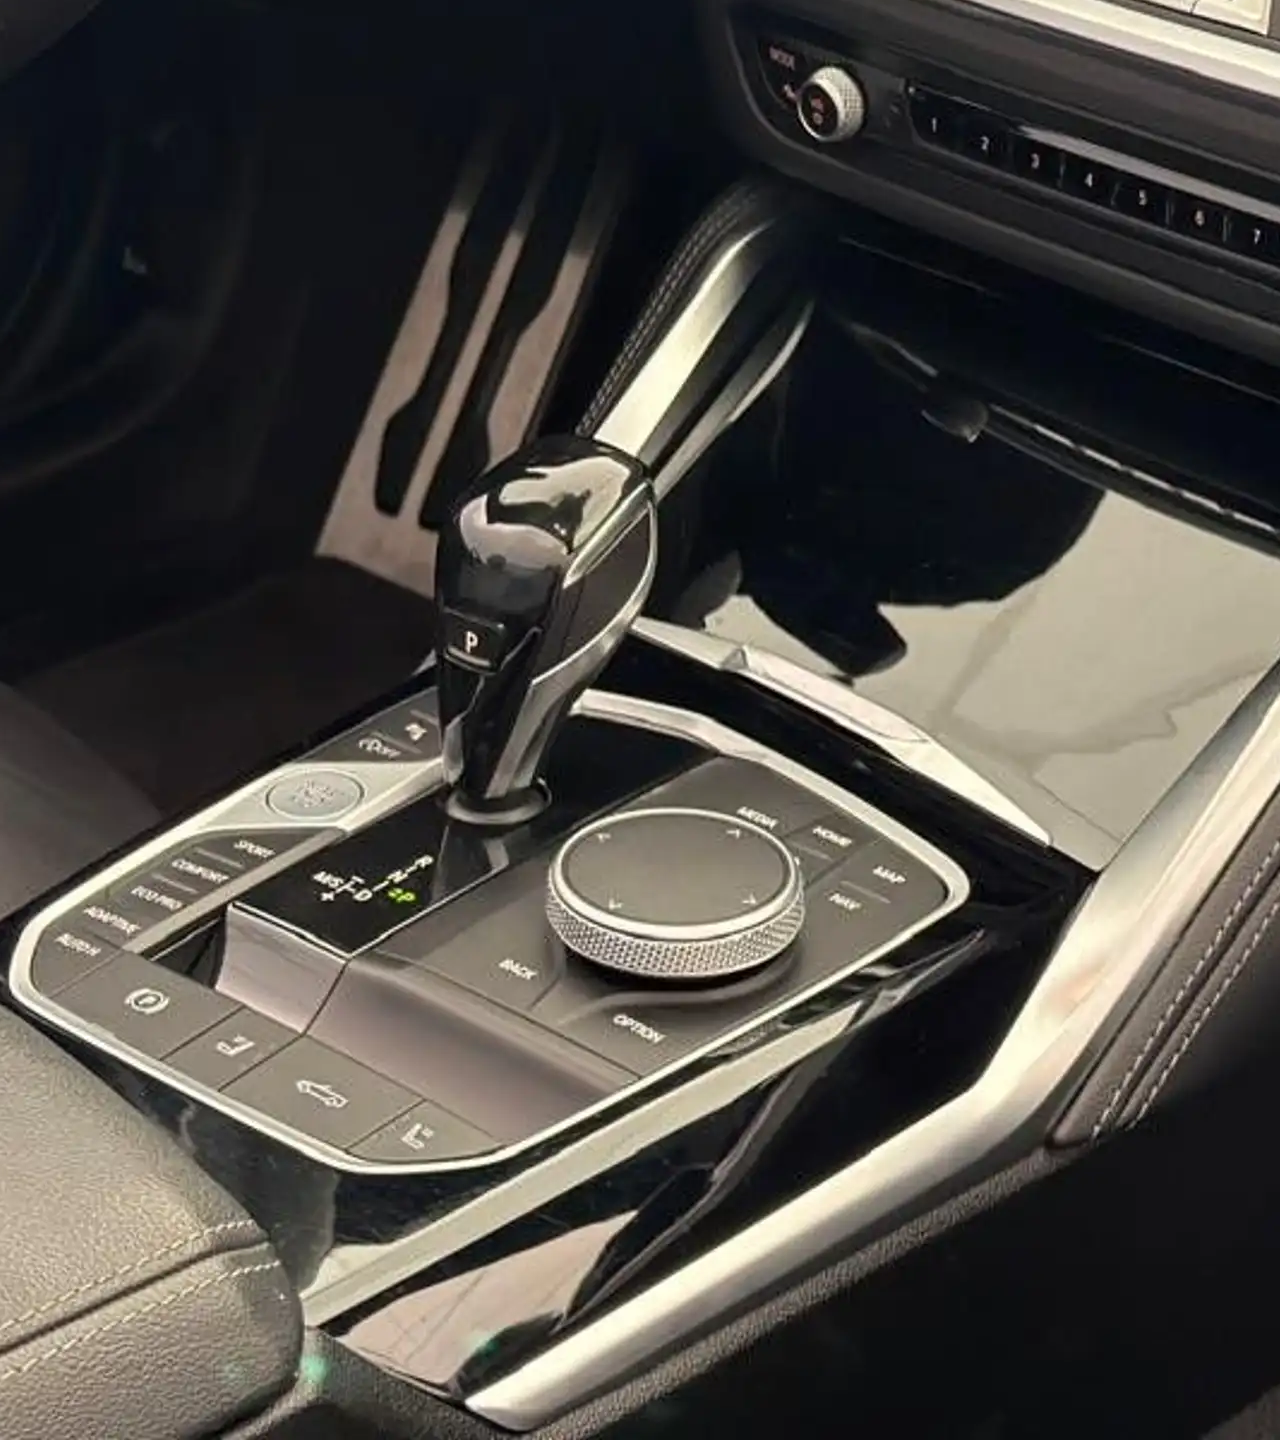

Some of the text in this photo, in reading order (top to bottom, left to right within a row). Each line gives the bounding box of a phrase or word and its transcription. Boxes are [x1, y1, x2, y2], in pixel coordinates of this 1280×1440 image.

[931, 116, 938, 134] 1
[980, 135, 990, 151] 2
[1084, 172, 1094, 189] 4
[1253, 227, 1262, 245] 7
[465, 630, 479, 654] P
[736, 806, 779, 831] MEDIA
[812, 825, 853, 847] HOME
[233, 838, 276, 859] SPORT
[170, 858, 231, 884] COMFORT
[872, 866, 906, 884] MAP
[131, 885, 185, 911] ECO PRO
[353, 888, 373, 901] D
[828, 892, 862, 911] NAV
[83, 905, 143, 935] ADAPTIVE
[498, 958, 538, 981] BACK
[612, 1013, 667, 1044] OPTION
